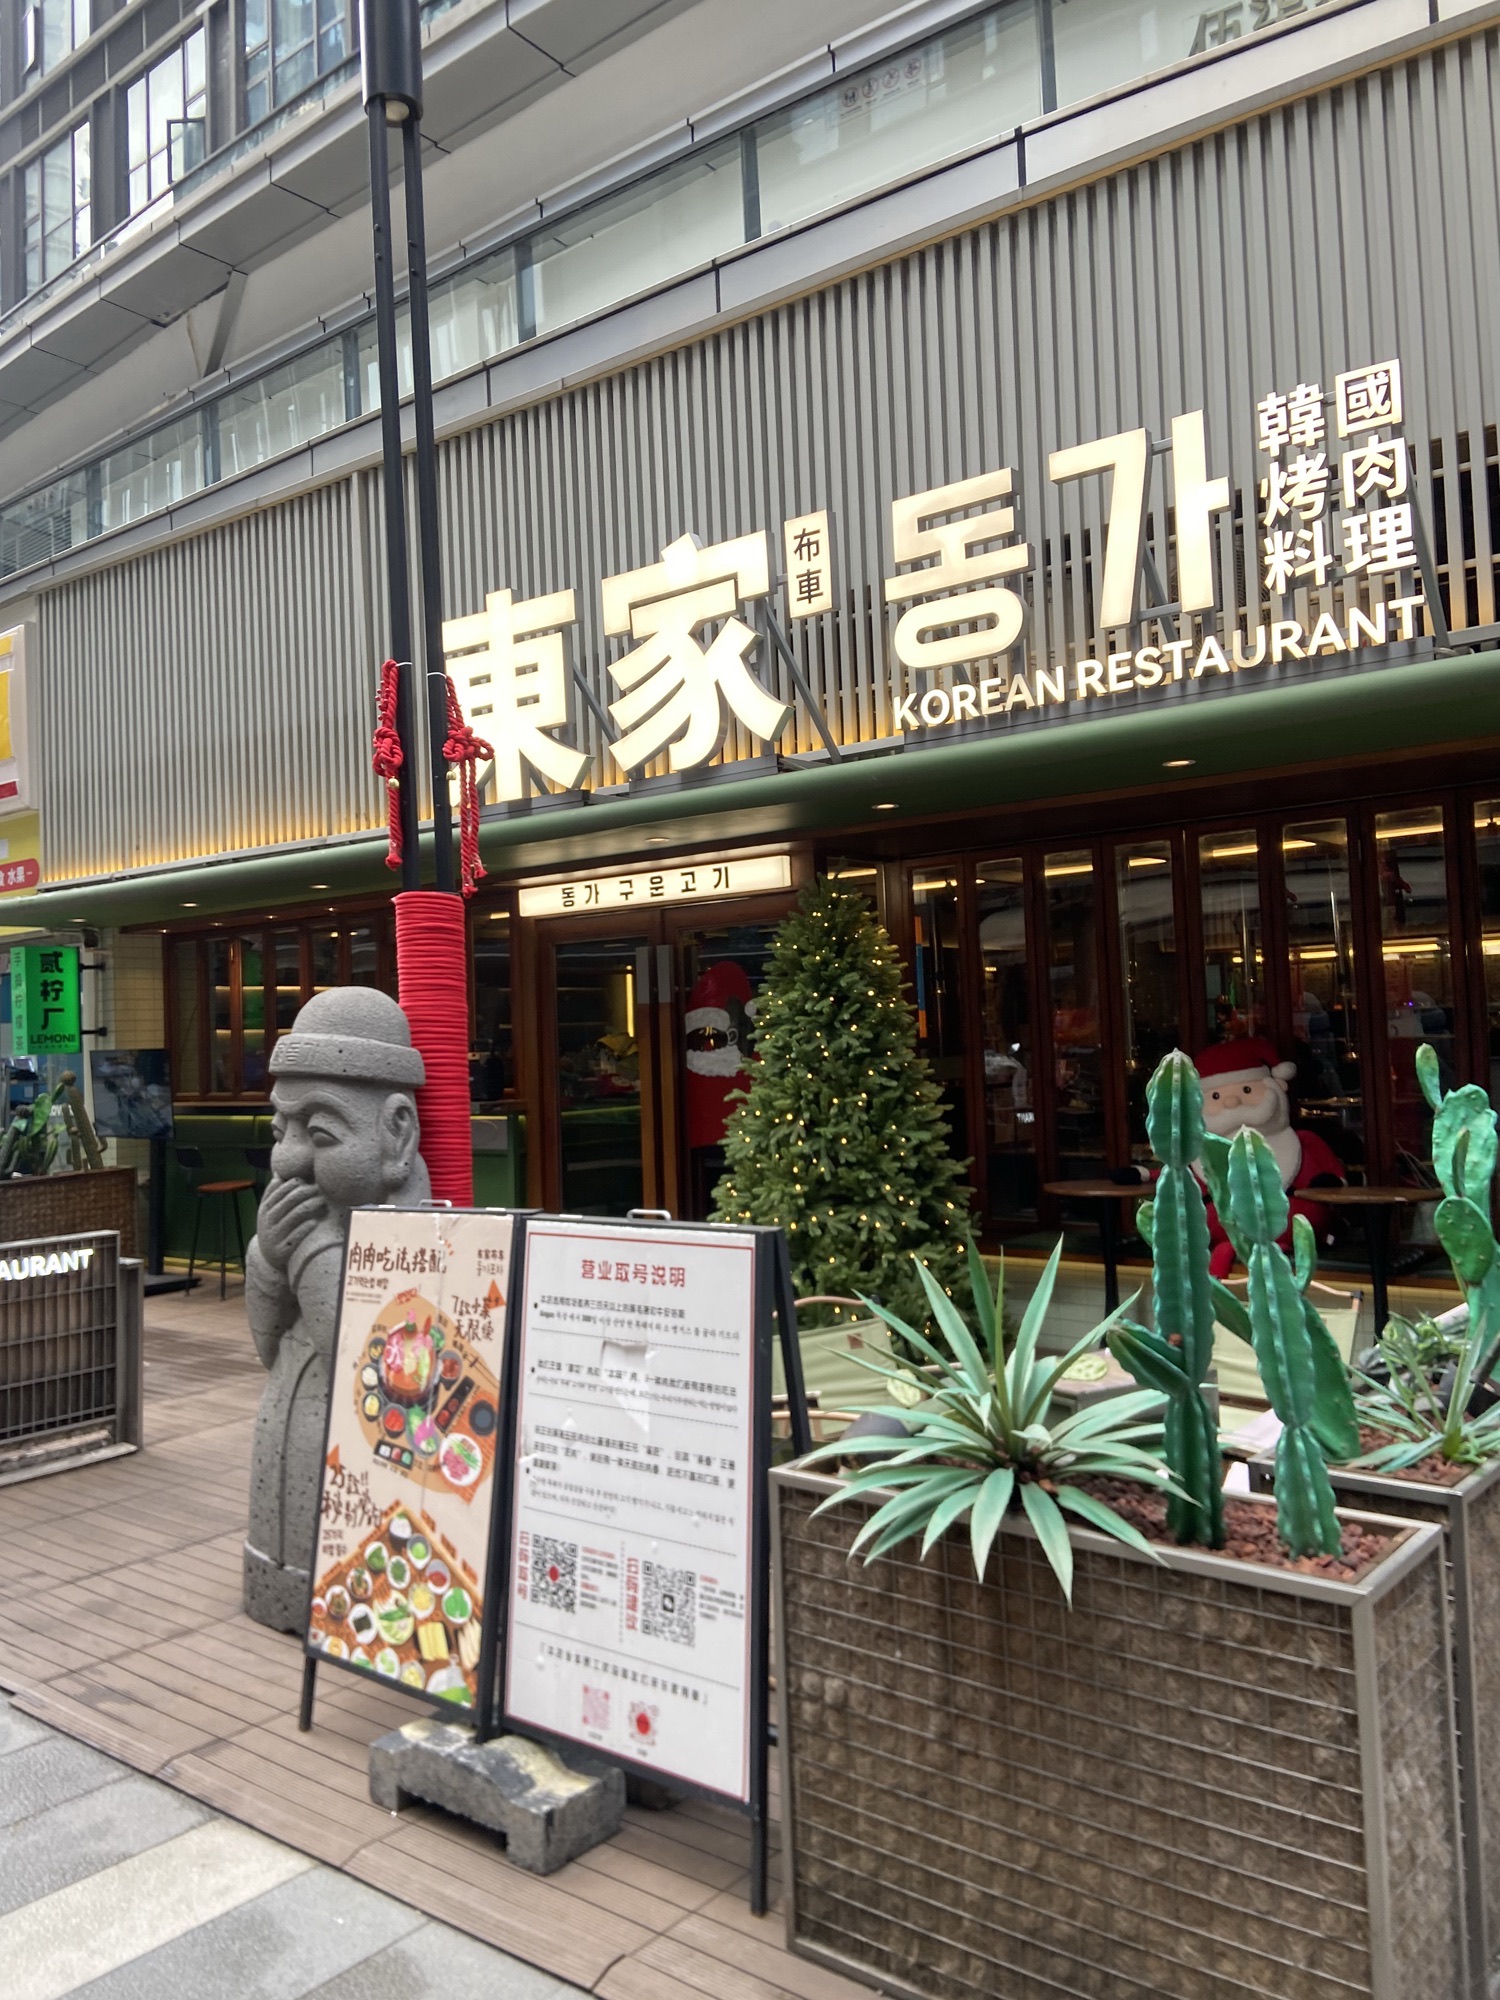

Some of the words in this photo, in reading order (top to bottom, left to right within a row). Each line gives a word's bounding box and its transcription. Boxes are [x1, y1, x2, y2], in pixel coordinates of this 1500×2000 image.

[793, 527, 824, 605] 布車
[885, 409, 1232, 668] 동가
[442, 532, 793, 804] 東家
[893, 666, 1066, 730] KOREAN
[1078, 595, 1426, 695] RESTAURANT
[561, 884, 600, 908] 동가
[40, 951, 64, 1030] 贰柠厂
[581, 1260, 686, 1288] 营业取号说明
